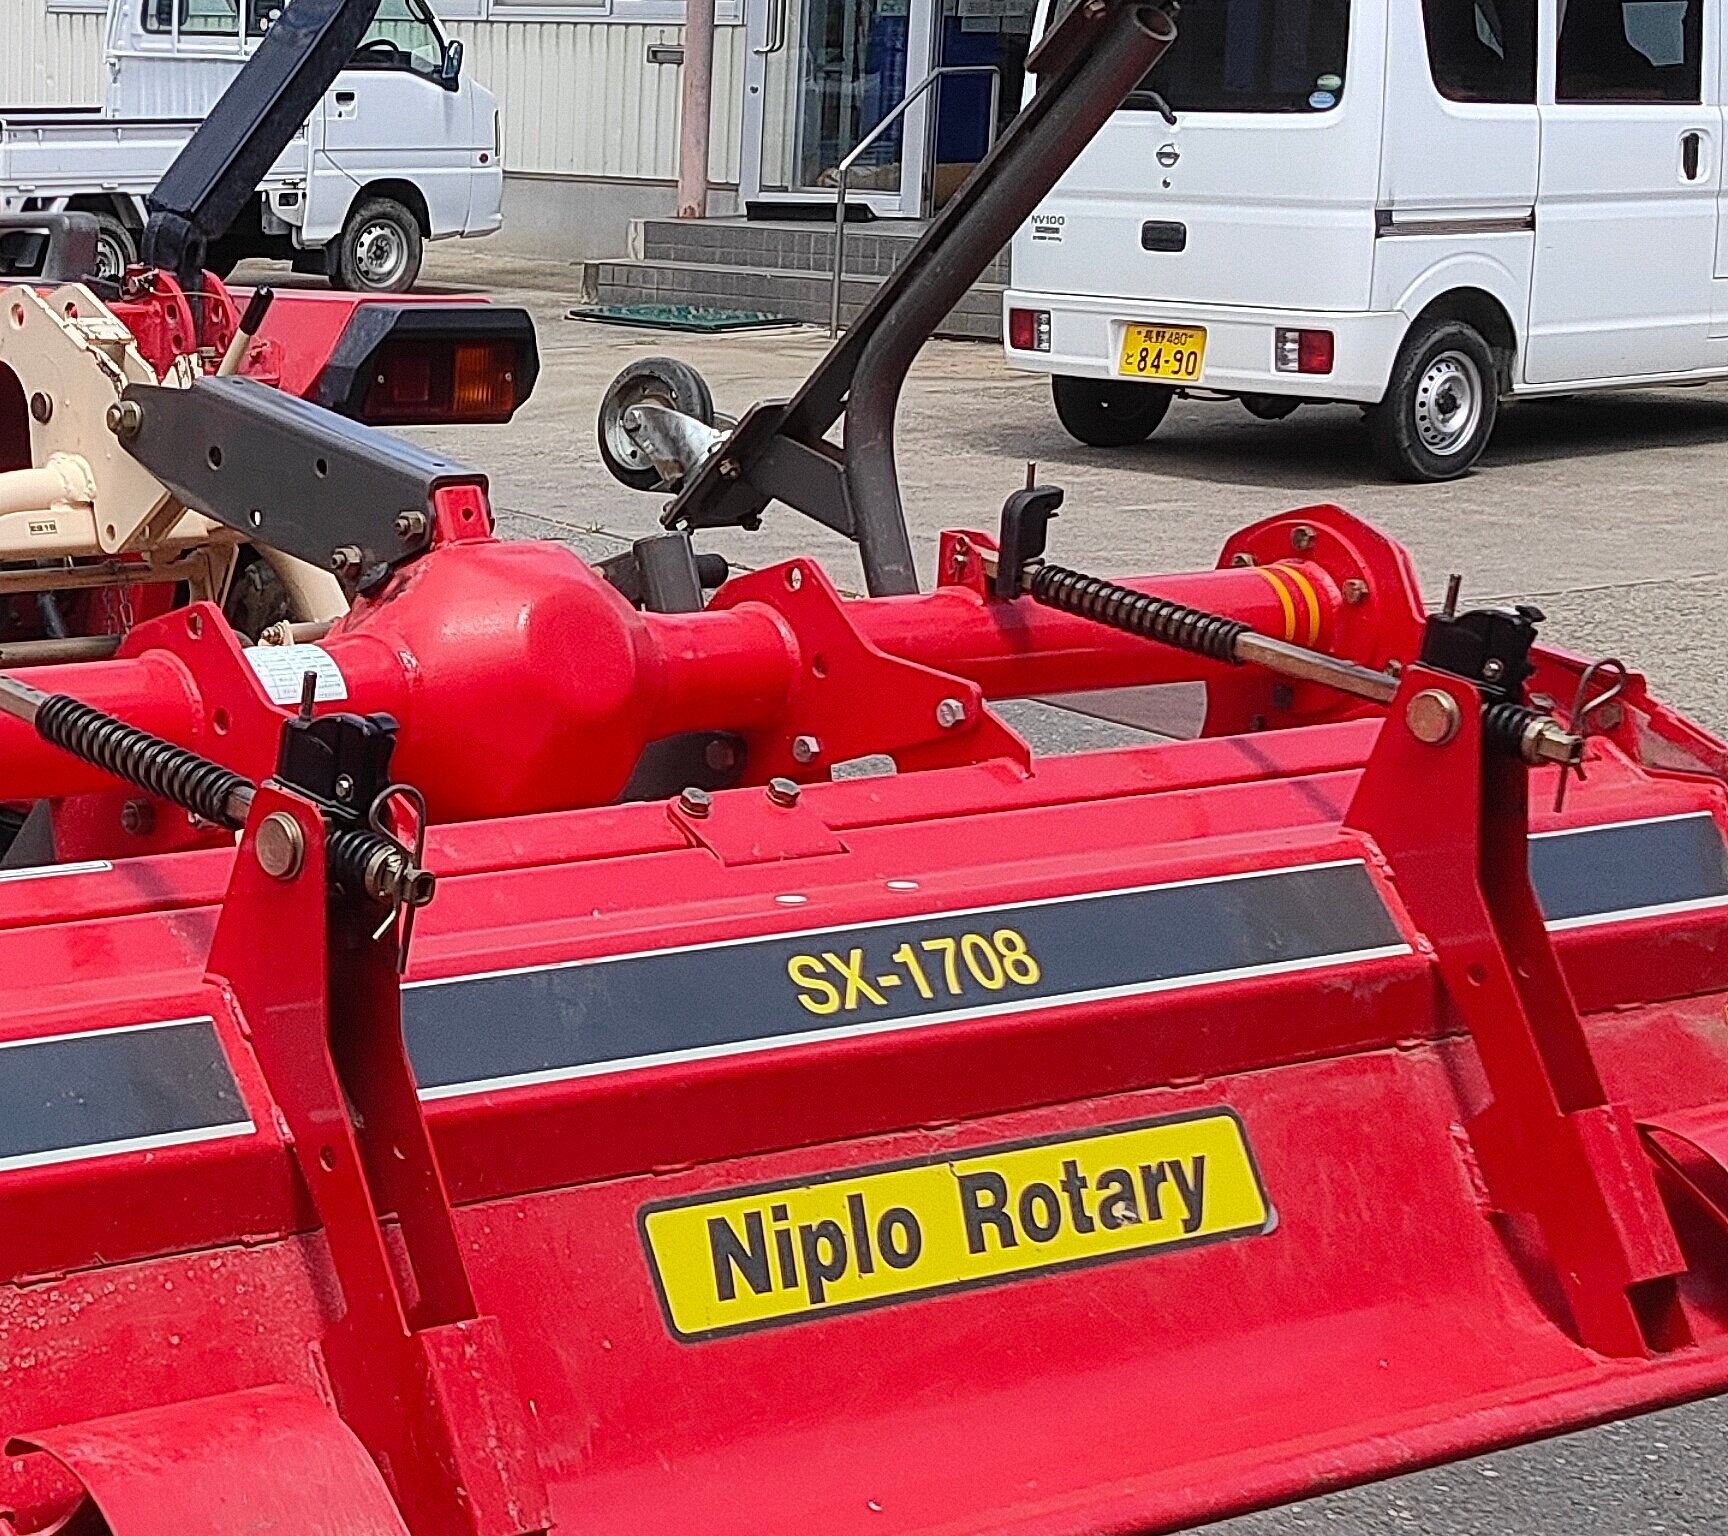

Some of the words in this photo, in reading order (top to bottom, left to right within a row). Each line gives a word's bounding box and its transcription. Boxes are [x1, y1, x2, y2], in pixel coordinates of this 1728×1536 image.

[1031, 215, 1065, 225] NV100
[1137, 347, 1198, 376] 84-90
[787, 928, 1041, 1015] SX-1708
[707, 1193, 922, 1305] Niplo
[956, 1154, 1206, 1254] Rotary
